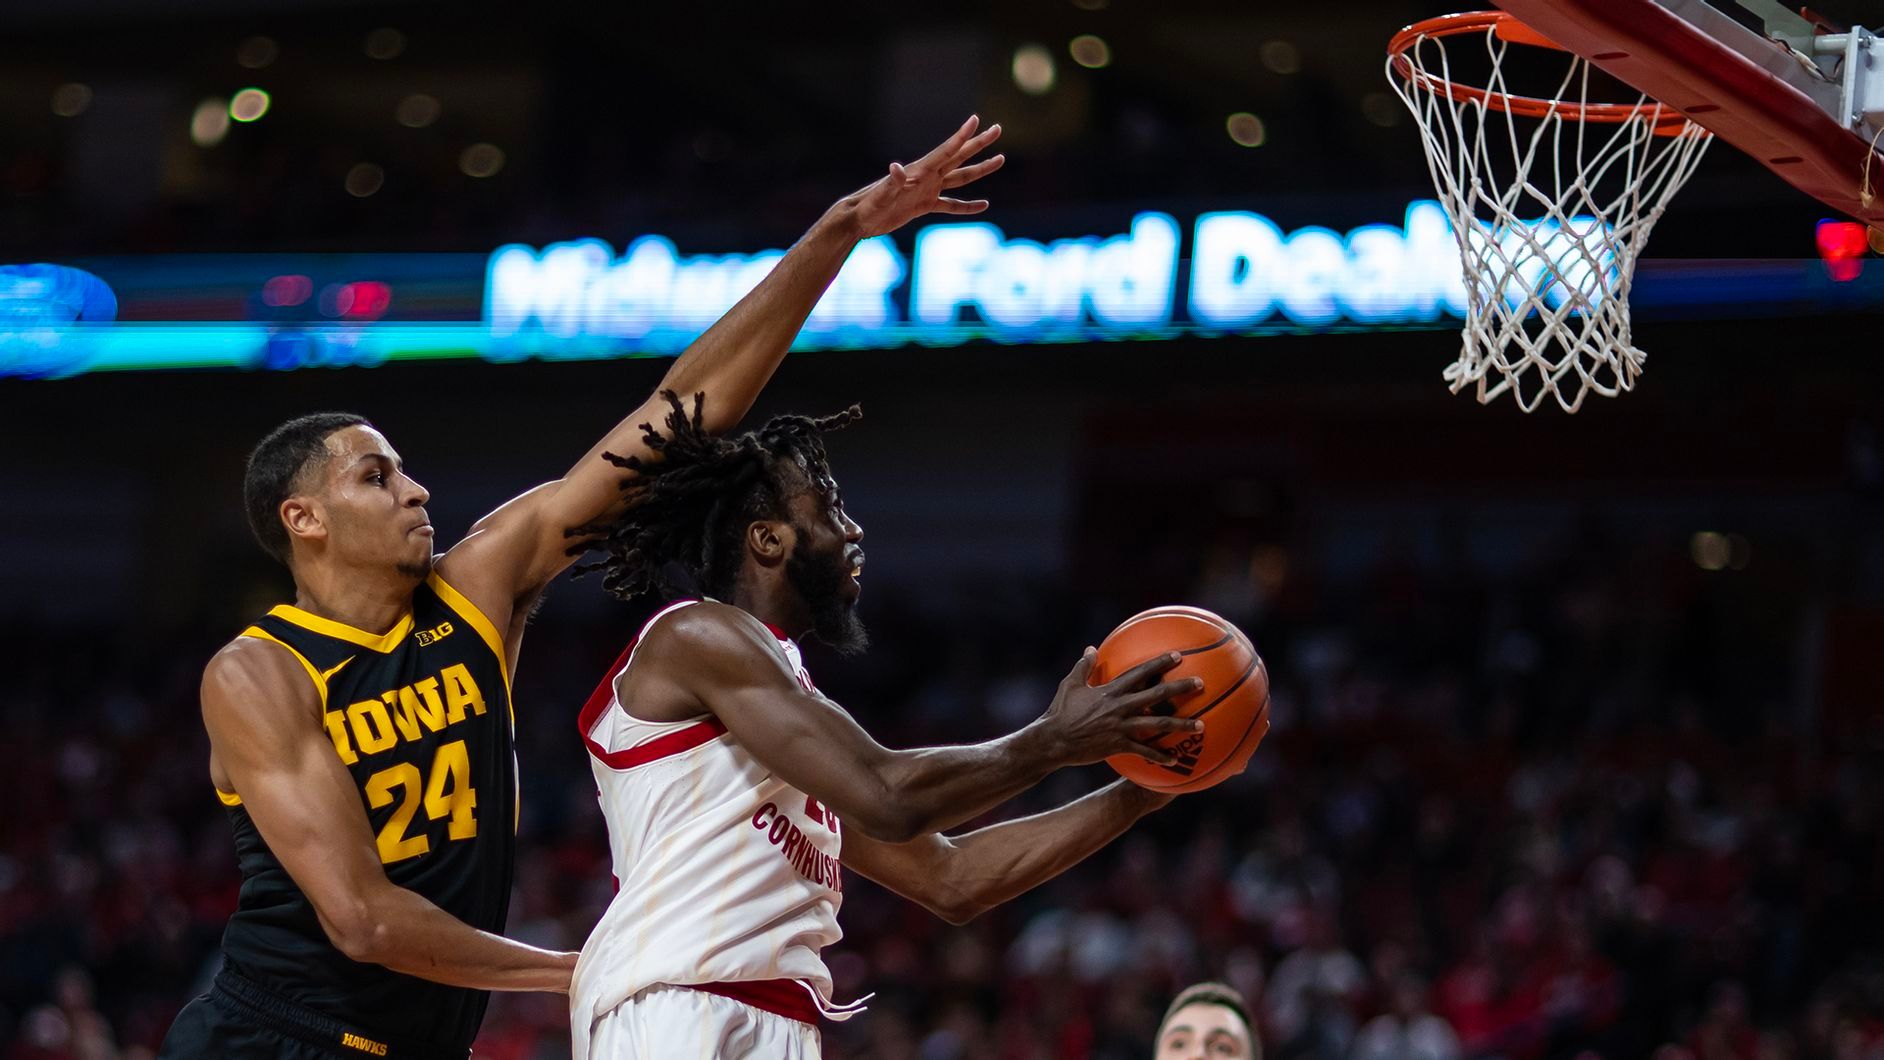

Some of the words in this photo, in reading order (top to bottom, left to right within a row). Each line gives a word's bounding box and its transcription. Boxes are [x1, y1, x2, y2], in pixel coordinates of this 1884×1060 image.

[484, 235, 906, 352] Midwt
[910, 211, 1180, 332] Ford
[326, 662, 487, 766] IOWA
[365, 739, 477, 864] 24
[751, 801, 843, 893] CORNHUSK
[342, 1032, 388, 1057] HAWKS
